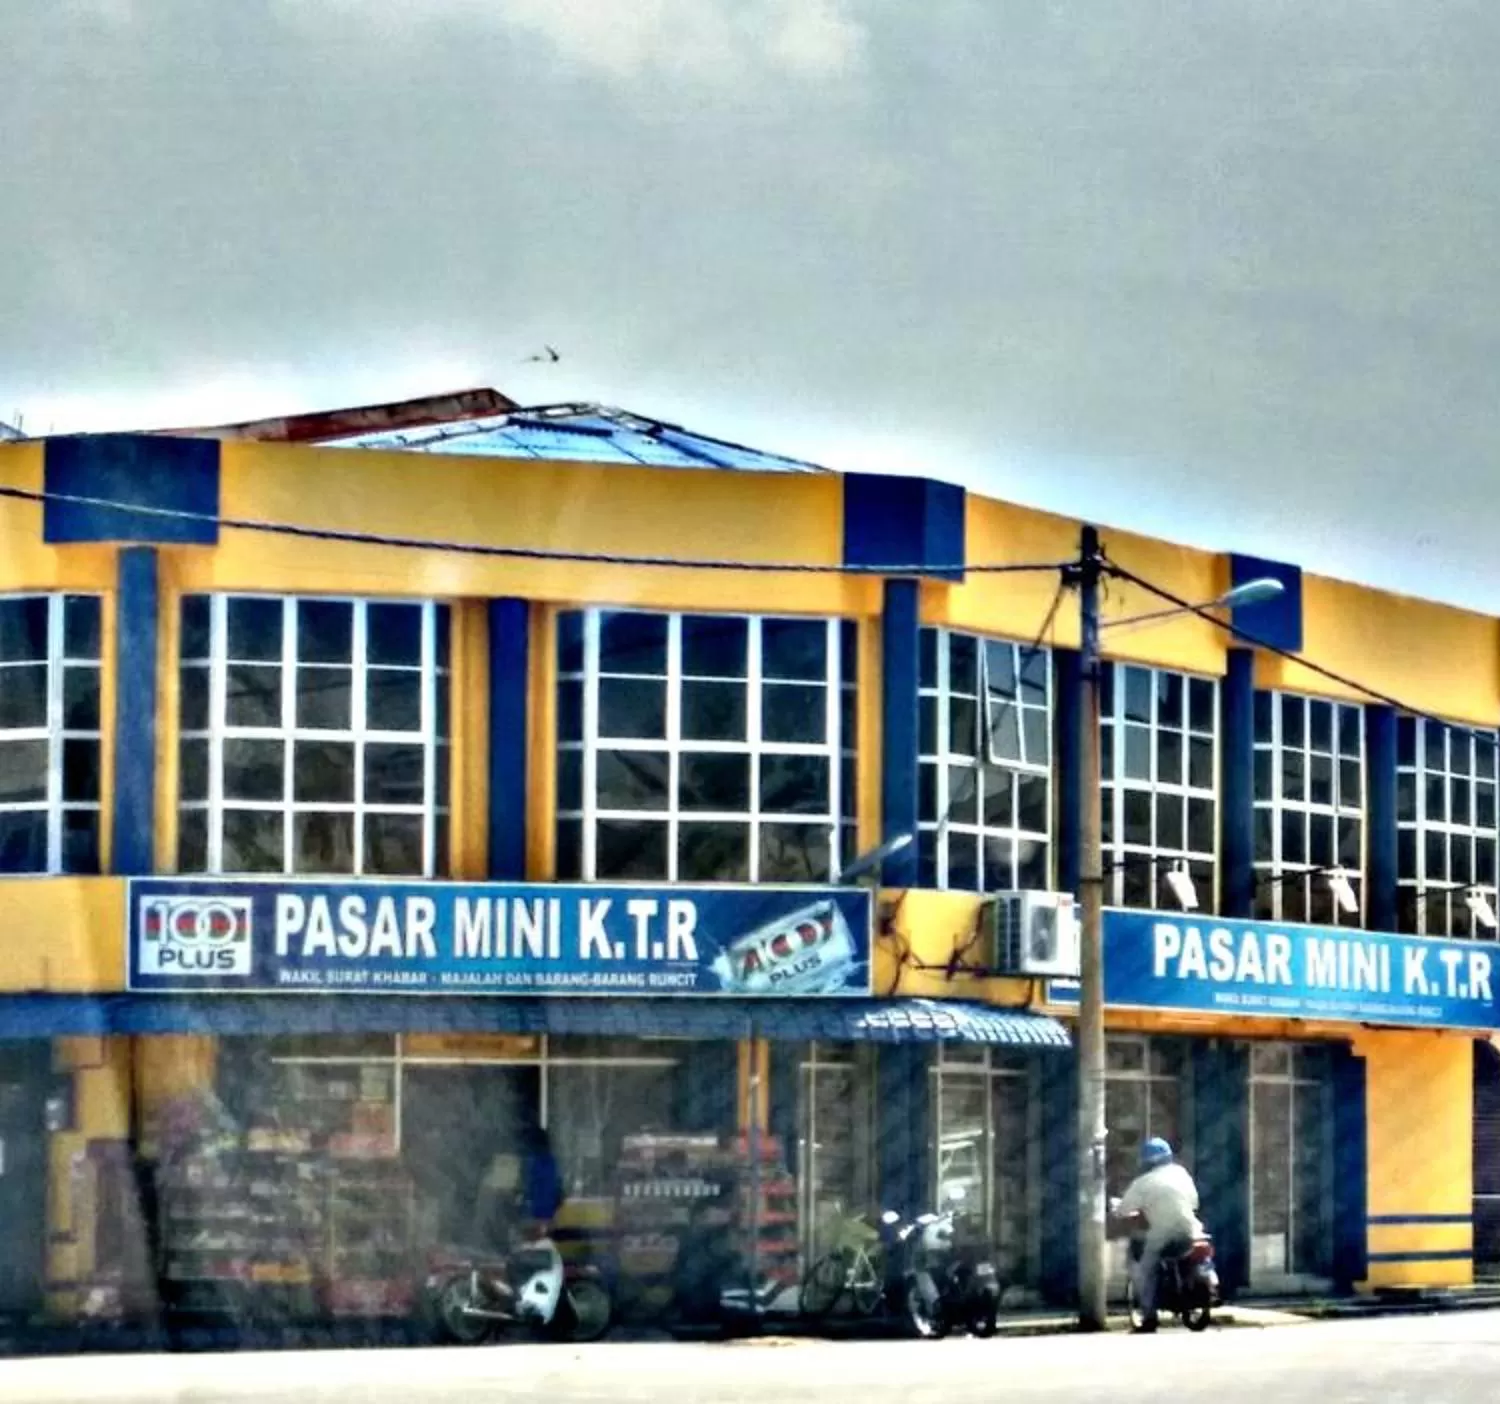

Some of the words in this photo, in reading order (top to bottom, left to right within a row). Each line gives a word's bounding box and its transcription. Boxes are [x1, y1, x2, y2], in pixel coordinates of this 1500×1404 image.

[275, 893, 437, 958] PASAR
[454, 897, 561, 959] MINI
[579, 899, 699, 961] K.T.R
[158, 949, 236, 969] PLUS
[768, 952, 822, 984] PLUS
[1154, 923, 1292, 985] PASAR
[1304, 943, 1391, 993] MINI
[1404, 949, 1492, 1001] K.T.R
[326, 969, 369, 984] SURAT
[373, 971, 427, 985] KHABAR
[441, 972, 501, 985] MAJALAH
[506, 973, 532, 985] DAN
[536, 973, 645, 986] BARANG-BARANG
[649, 974, 698, 986] RUNCIT
